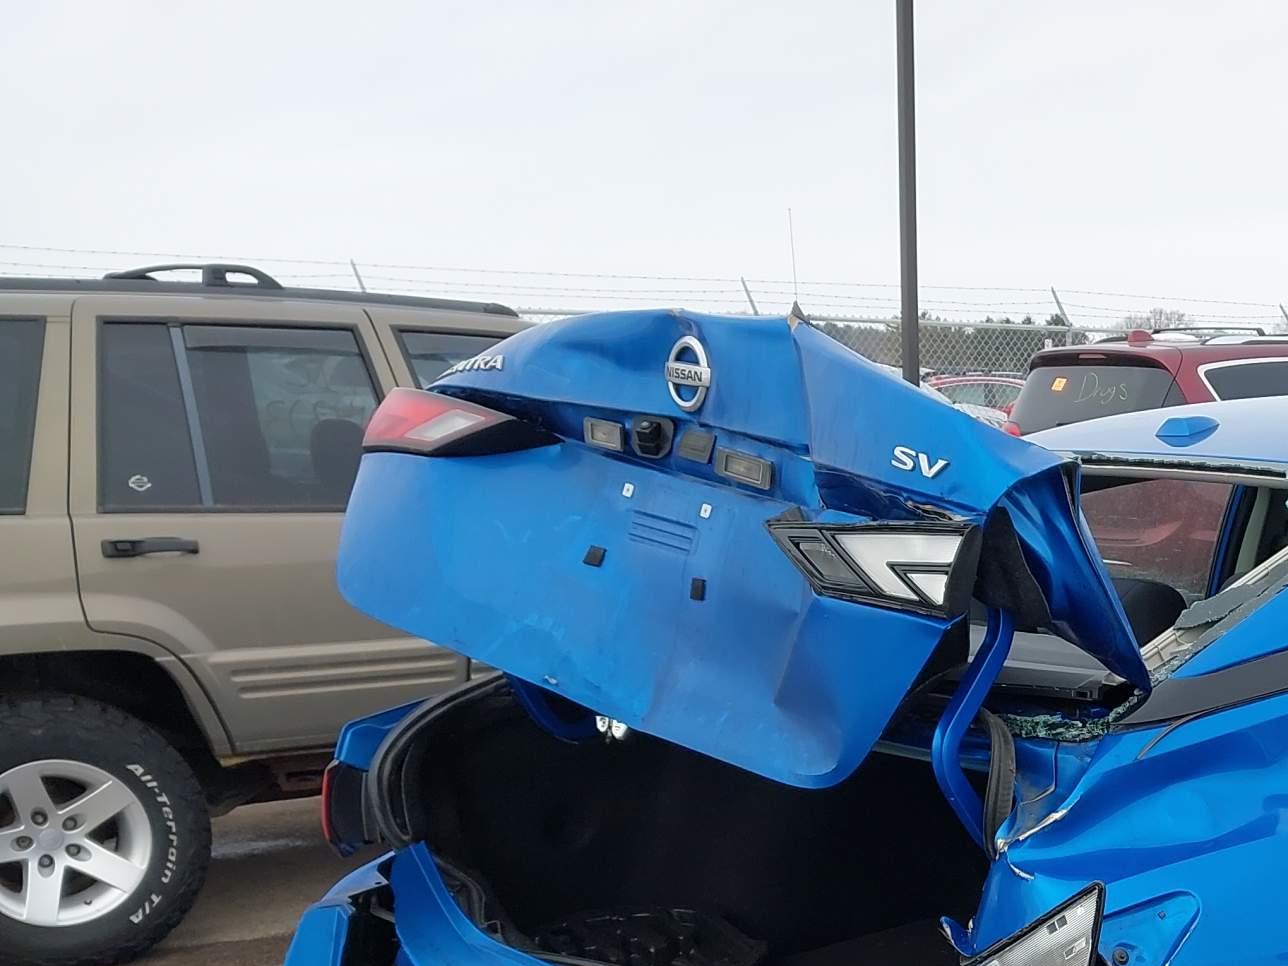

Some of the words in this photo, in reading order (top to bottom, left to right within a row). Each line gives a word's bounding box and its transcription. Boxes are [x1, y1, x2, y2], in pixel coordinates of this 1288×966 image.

[667, 366, 703, 382] NISSAN
[891, 446, 949, 478] SV
[126, 764, 177, 884] All-Terrain
[129, 893, 162, 924] T/A
